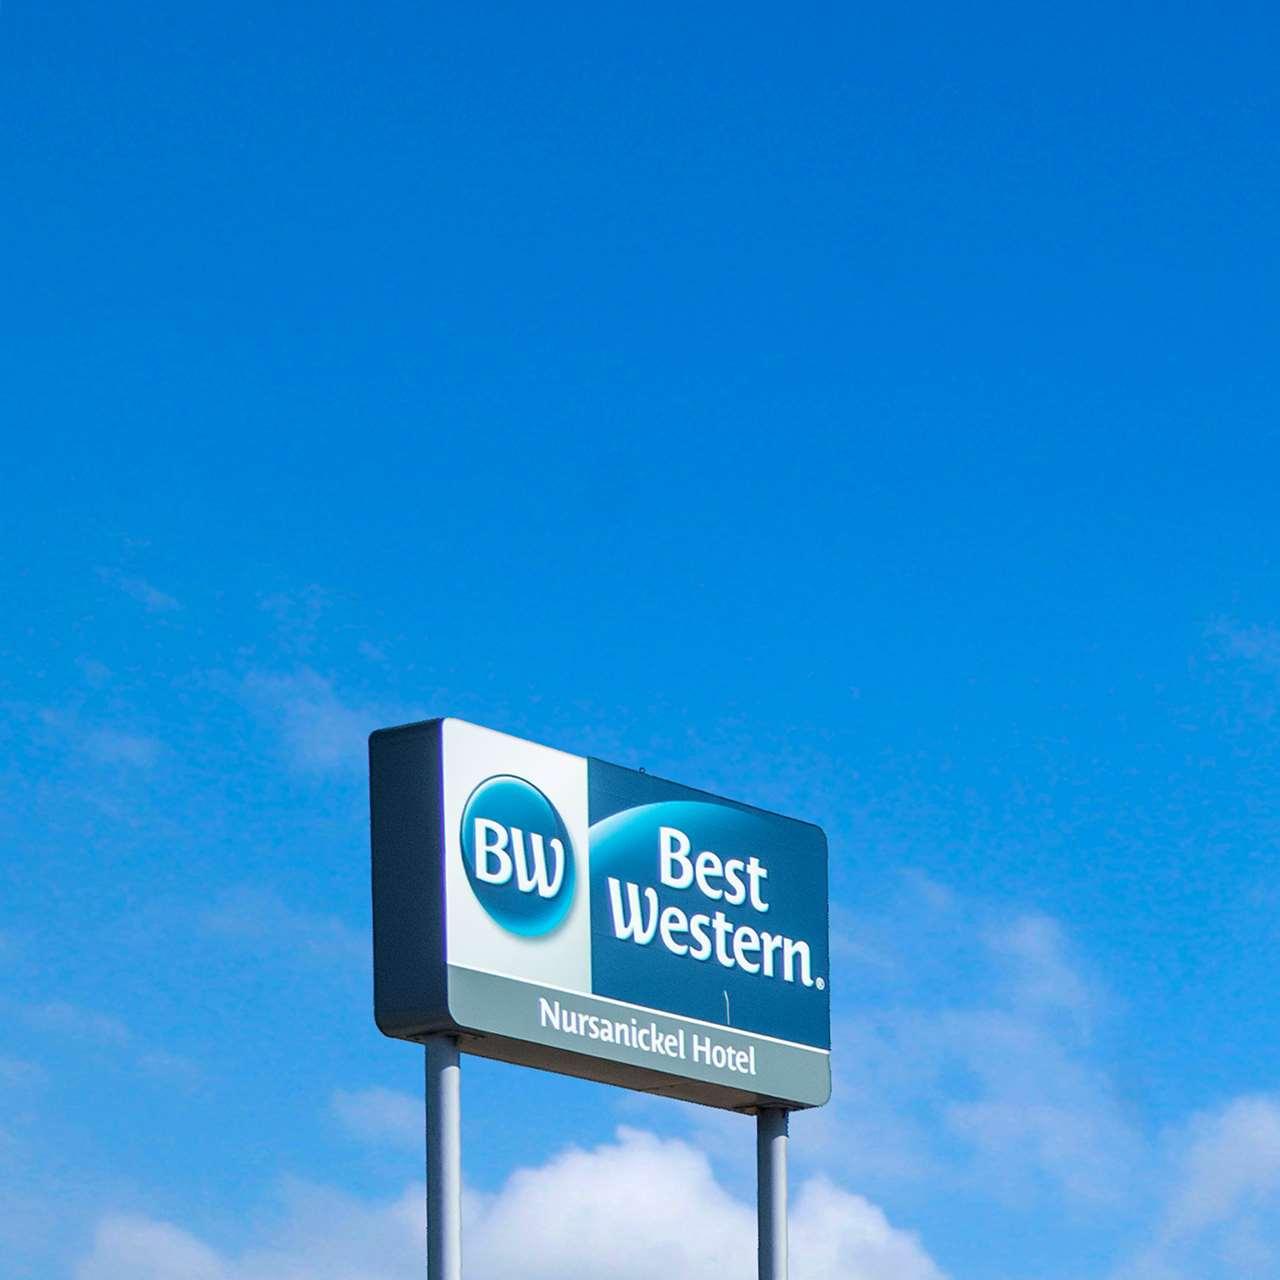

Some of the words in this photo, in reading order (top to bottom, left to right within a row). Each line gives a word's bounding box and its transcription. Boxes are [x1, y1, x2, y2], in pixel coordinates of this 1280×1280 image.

[474, 817, 566, 899] BW
[658, 826, 770, 913] Best
[538, 997, 686, 1059] Nursanickel
[692, 1037, 757, 1075] Hotel
